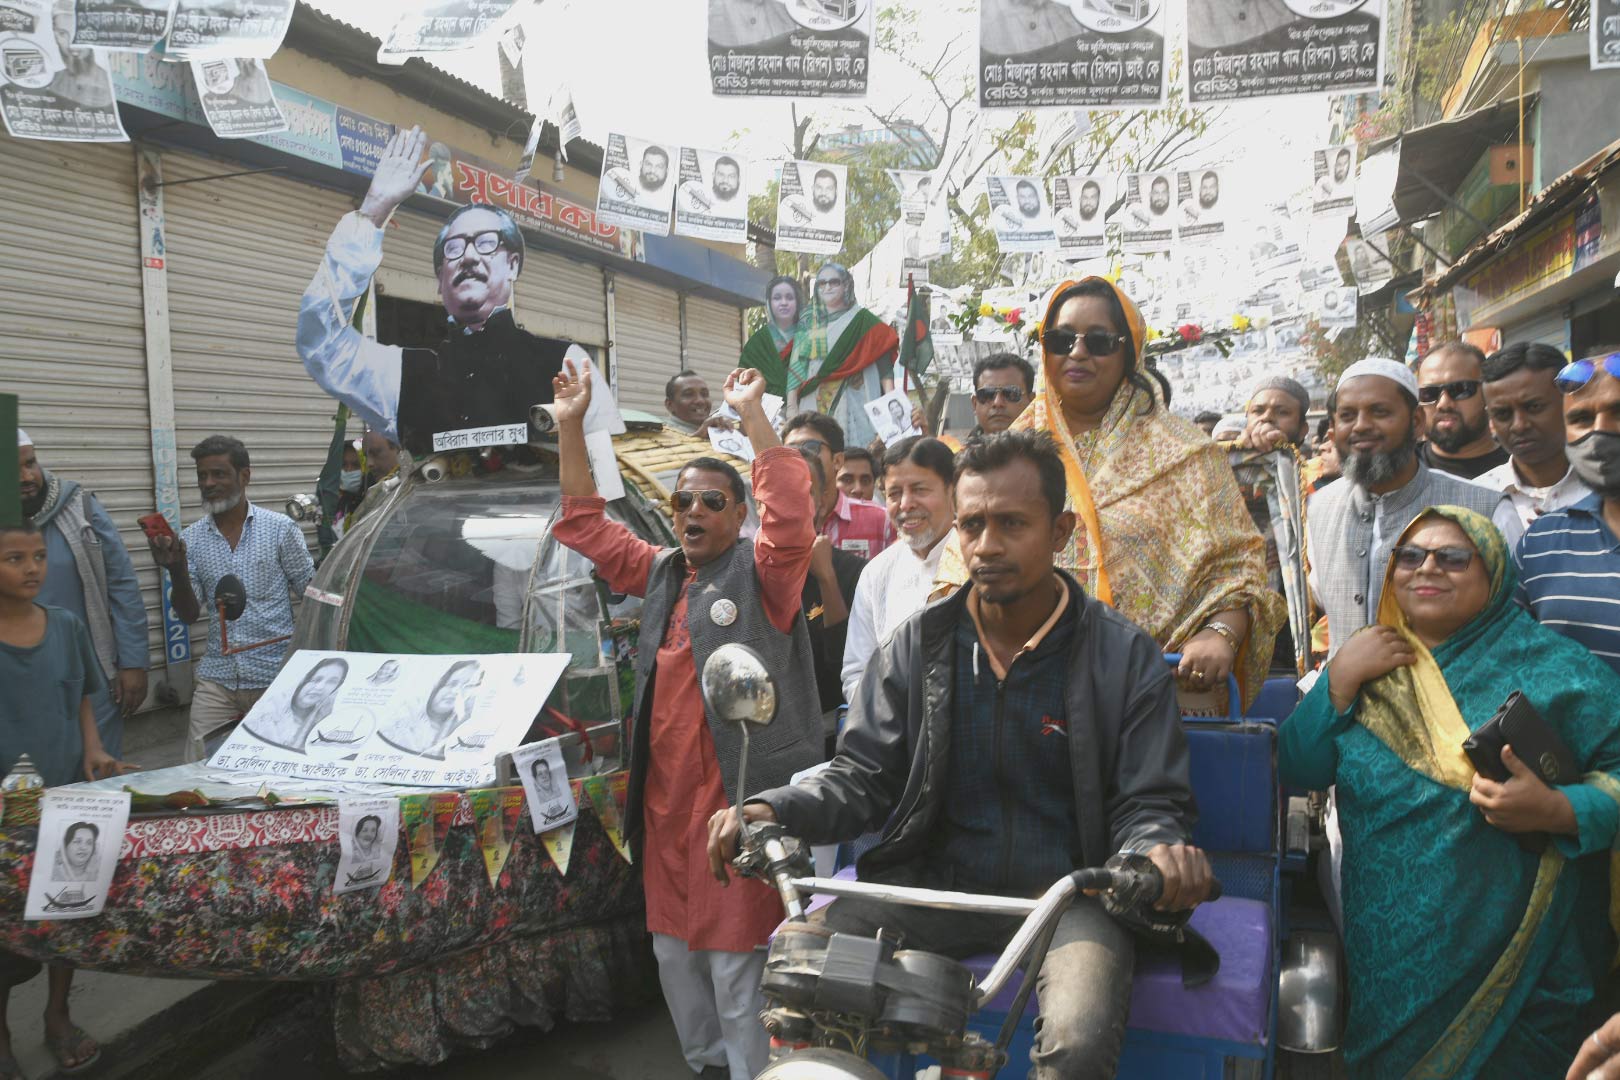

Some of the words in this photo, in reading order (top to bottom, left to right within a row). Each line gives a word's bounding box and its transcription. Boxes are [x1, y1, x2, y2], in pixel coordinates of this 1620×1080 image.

[757, 55, 783, 73] রহমান
[834, 52, 851, 75] ভাই
[1250, 52, 1280, 74] রহমান
[1339, 39, 1359, 64] ভাই
[1040, 62, 1069, 82] রহমান
[1126, 56, 1145, 80] ভাই
[713, 72, 748, 88] রেডিও
[1194, 75, 1238, 94] রেডিও
[985, 82, 1028, 100] রেডিও
[457, 160, 553, 220] সুপার
[234, 755, 269, 770] সেলিনা
[373, 764, 410, 780] সেলিনা
